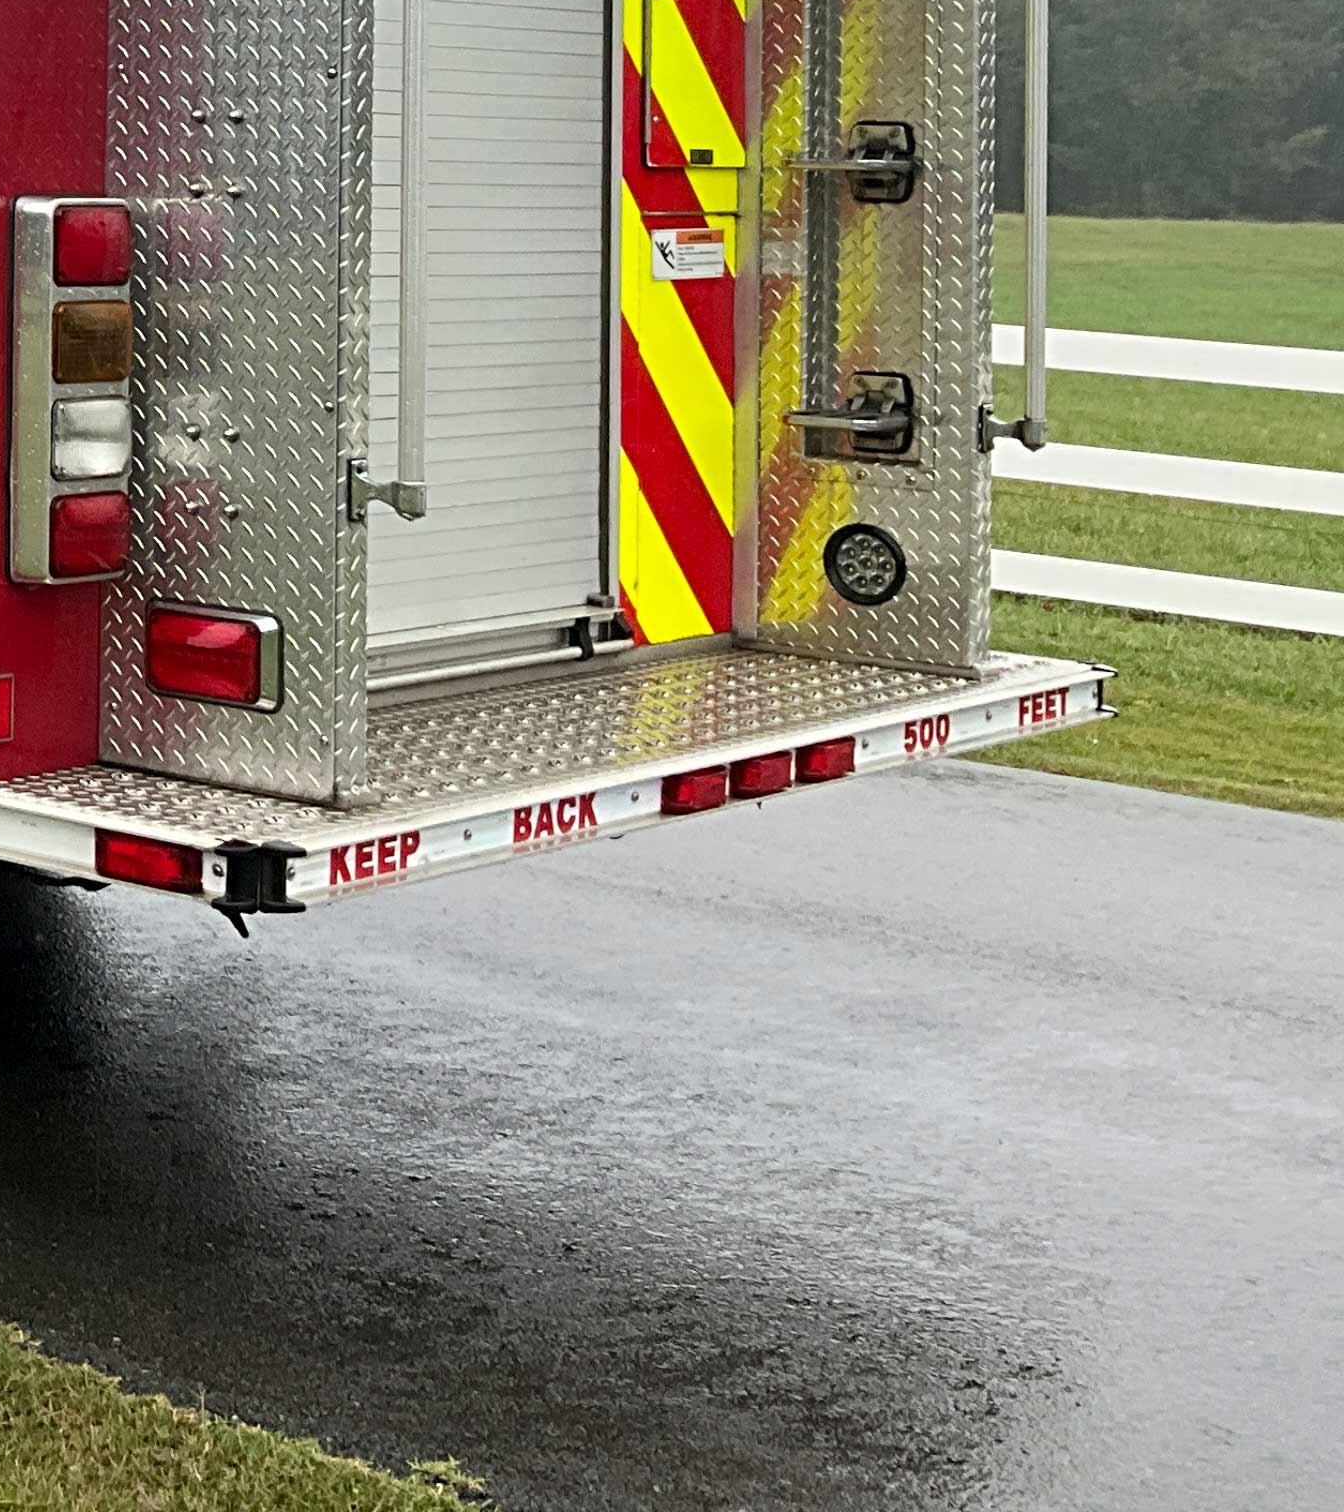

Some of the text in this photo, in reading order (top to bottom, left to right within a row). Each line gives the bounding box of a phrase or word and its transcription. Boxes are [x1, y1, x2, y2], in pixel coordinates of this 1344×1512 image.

[329, 687, 1070, 885] KEEP BACK 500 FEET
